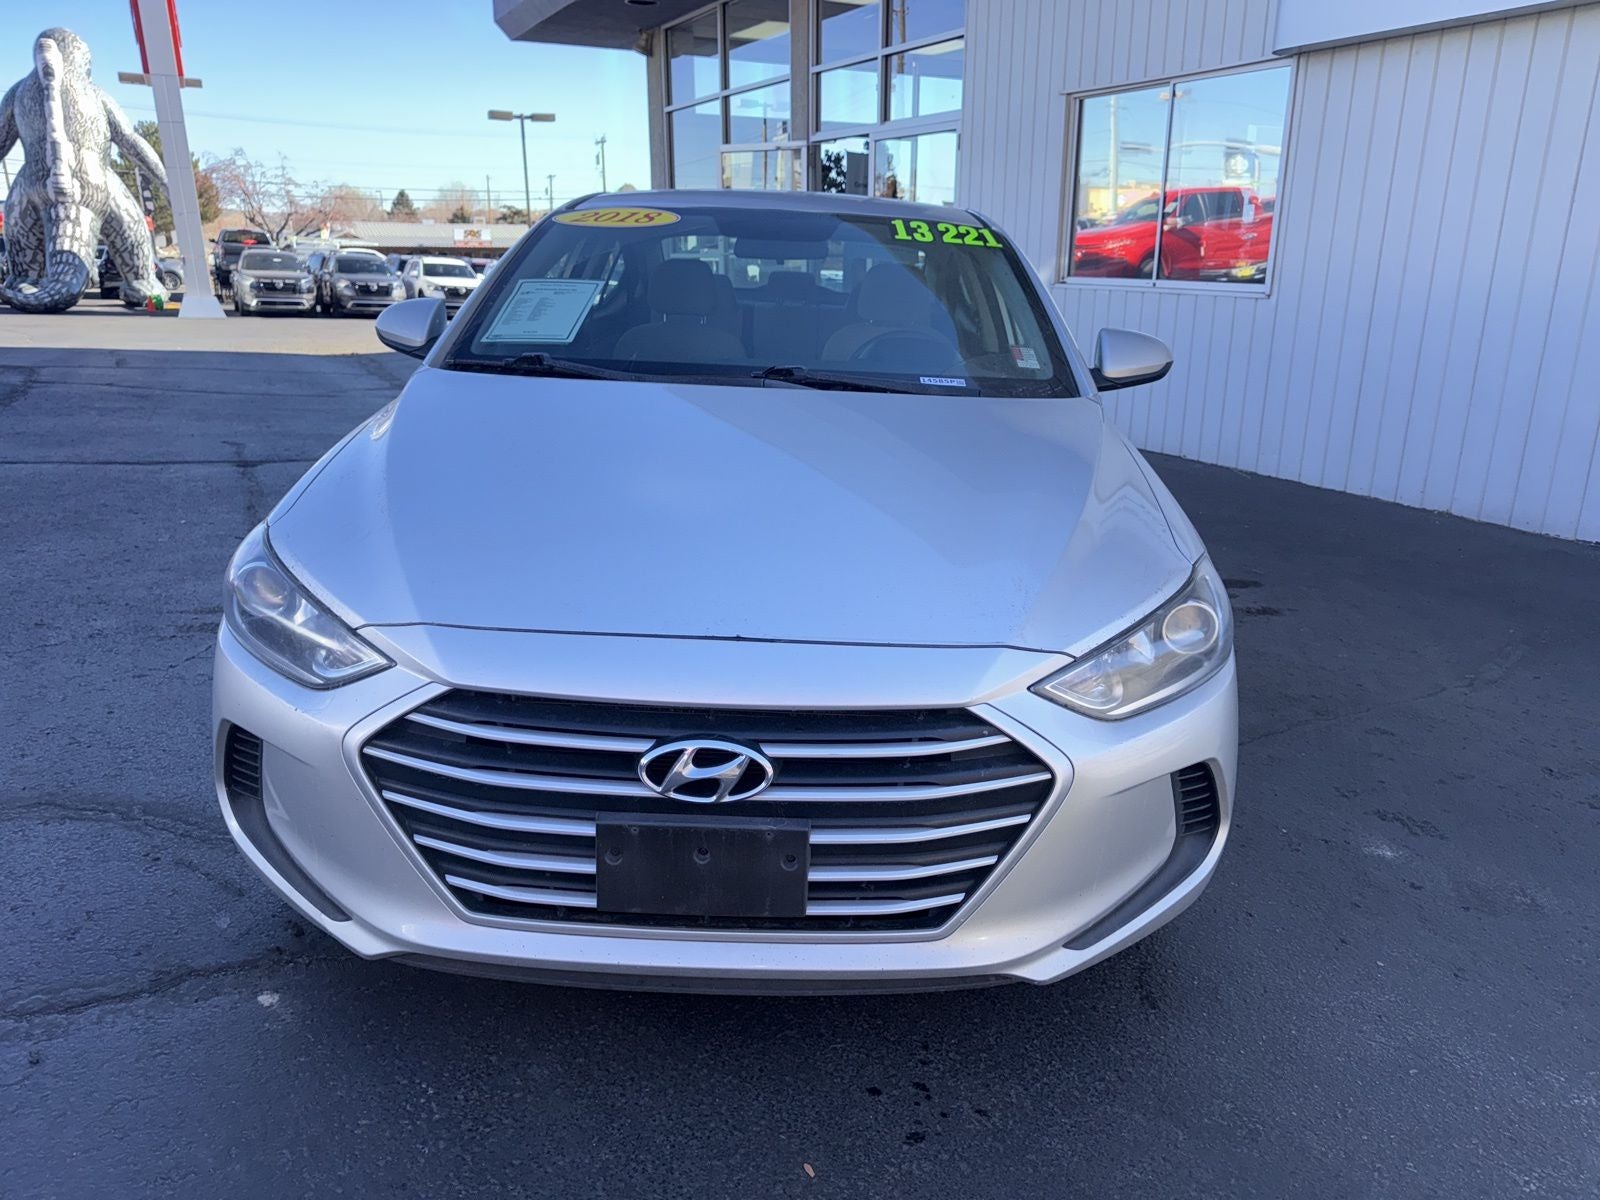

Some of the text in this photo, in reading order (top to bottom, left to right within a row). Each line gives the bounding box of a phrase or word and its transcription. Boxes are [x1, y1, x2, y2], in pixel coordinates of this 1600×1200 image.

[570, 211, 662, 223] 2018
[891, 219, 1003, 248] 13 221
